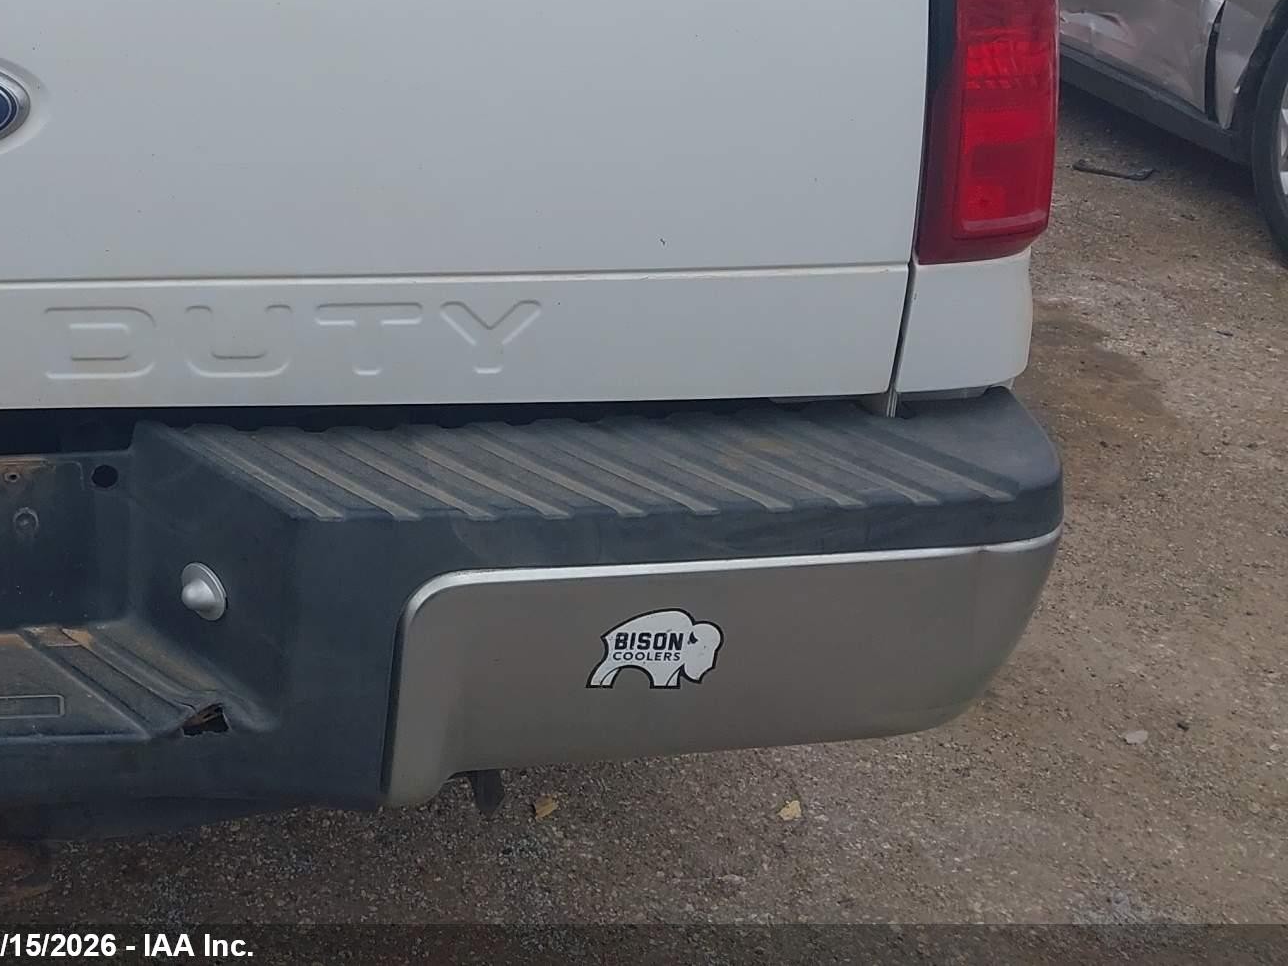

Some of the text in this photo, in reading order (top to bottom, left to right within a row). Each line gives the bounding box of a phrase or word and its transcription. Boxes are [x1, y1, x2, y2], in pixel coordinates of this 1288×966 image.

[45, 300, 542, 379] DUTY
[614, 632, 684, 650] BISON
[612, 651, 681, 661] COOLERS
